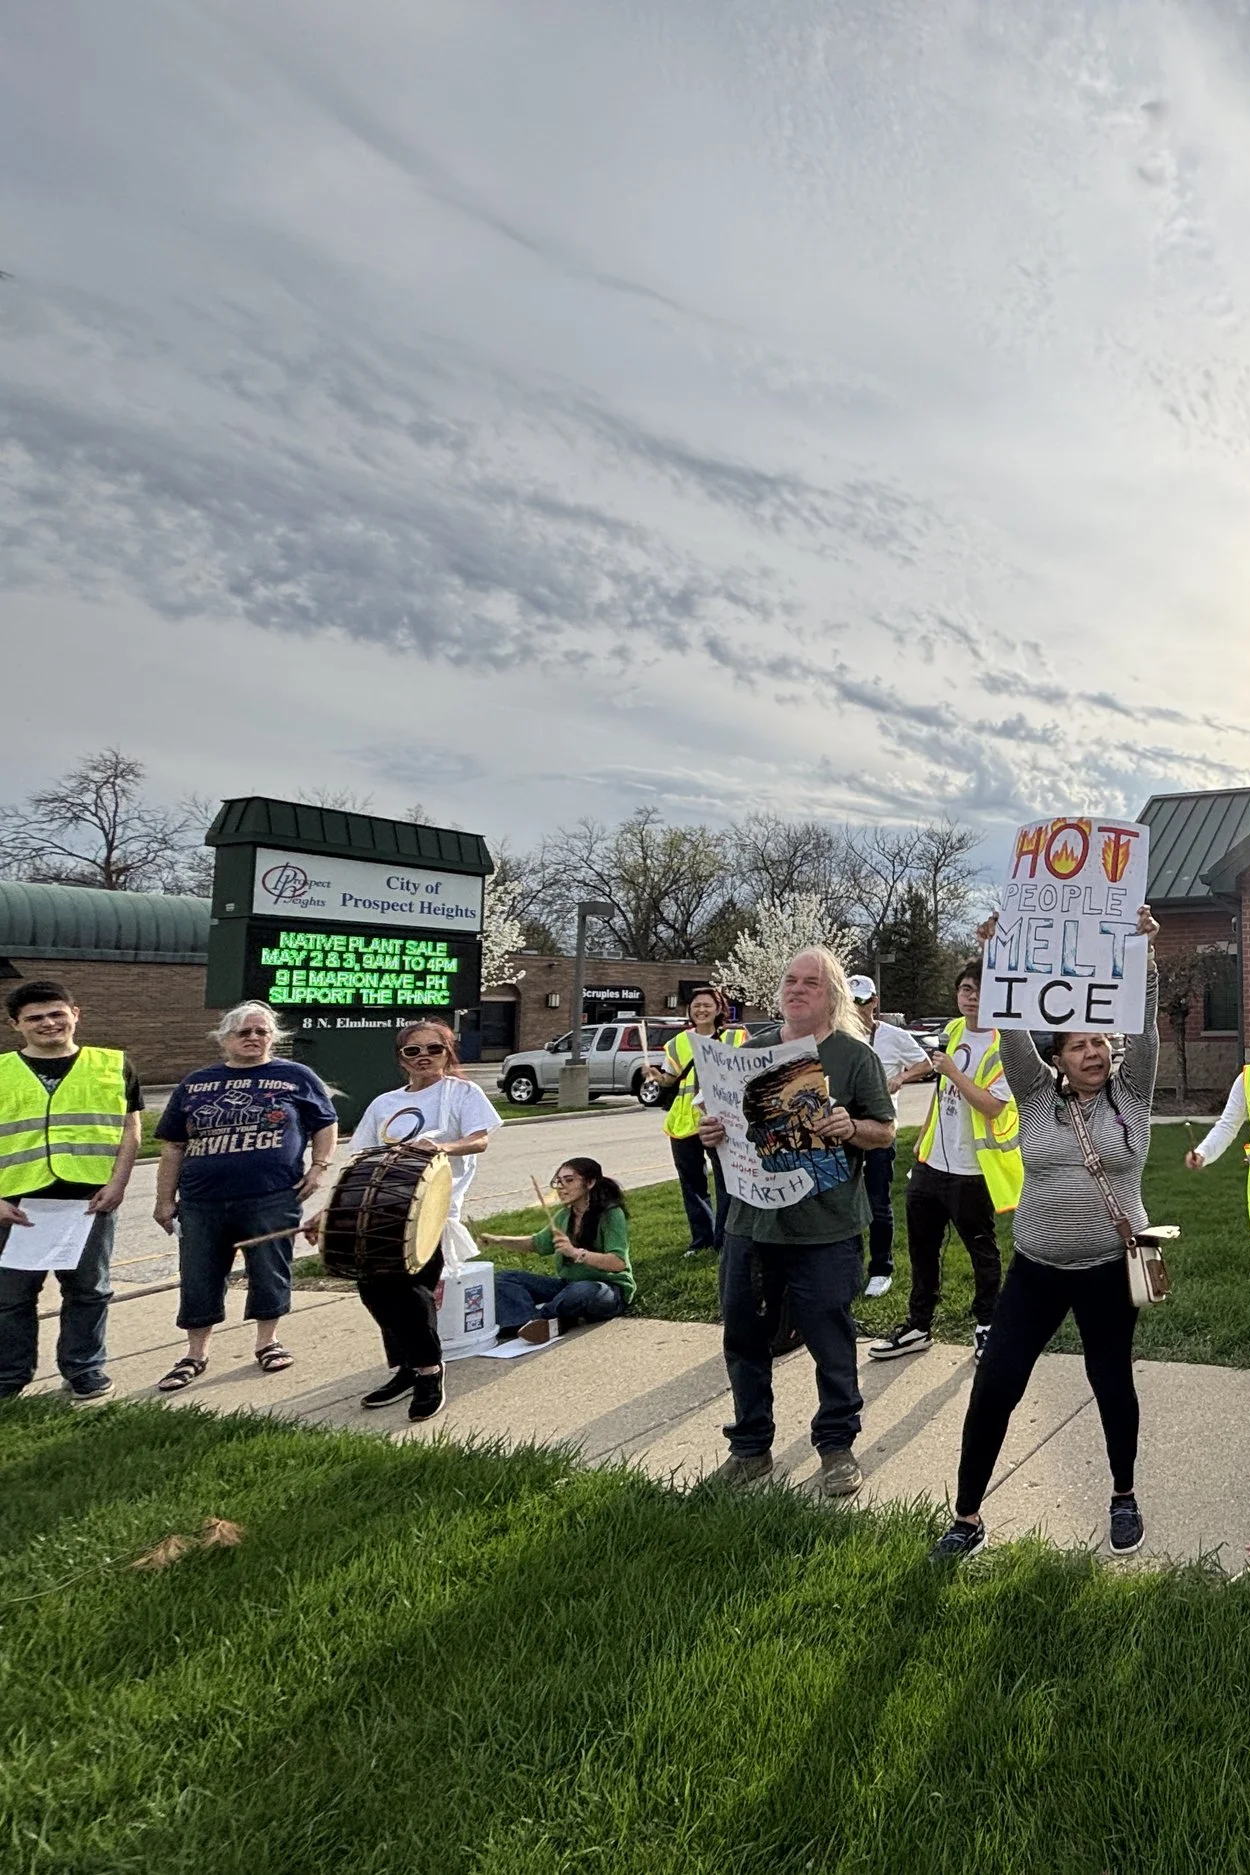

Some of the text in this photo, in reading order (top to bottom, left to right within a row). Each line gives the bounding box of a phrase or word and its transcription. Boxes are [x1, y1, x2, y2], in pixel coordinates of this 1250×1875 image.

[1012, 822, 1140, 883] HOT
[386, 875, 443, 895] City of
[340, 893, 477, 919] Prospect Heights
[1001, 883, 1127, 917] PEOPLE
[280, 932, 448, 957] NATIVE PLANT SALE
[987, 917, 1140, 980] MELT
[261, 948, 458, 973] MAY 2 & 3, 9AM TO 4PM
[275, 969, 290, 986] 9
[292, 970, 307, 986] E
[309, 970, 379, 988] MARION
[380, 973, 415, 989] AVE
[426, 975, 448, 989] PH
[269, 986, 450, 1005] SUPPORT THE PHNRC
[582, 988, 640, 1000] Scruples Hair
[992, 976, 1119, 1025] ICE
[303, 1018, 313, 1028] 8
[317, 1017, 332, 1028] N.
[336, 1017, 392, 1029] Elmhurst
[701, 1044, 774, 1073] MIGRATION
[225, 1079, 251, 1090] FOR
[236, 1125, 258, 1133] YOUR
[731, 1163, 759, 1178] HOME
[737, 1175, 803, 1203] EARTH
